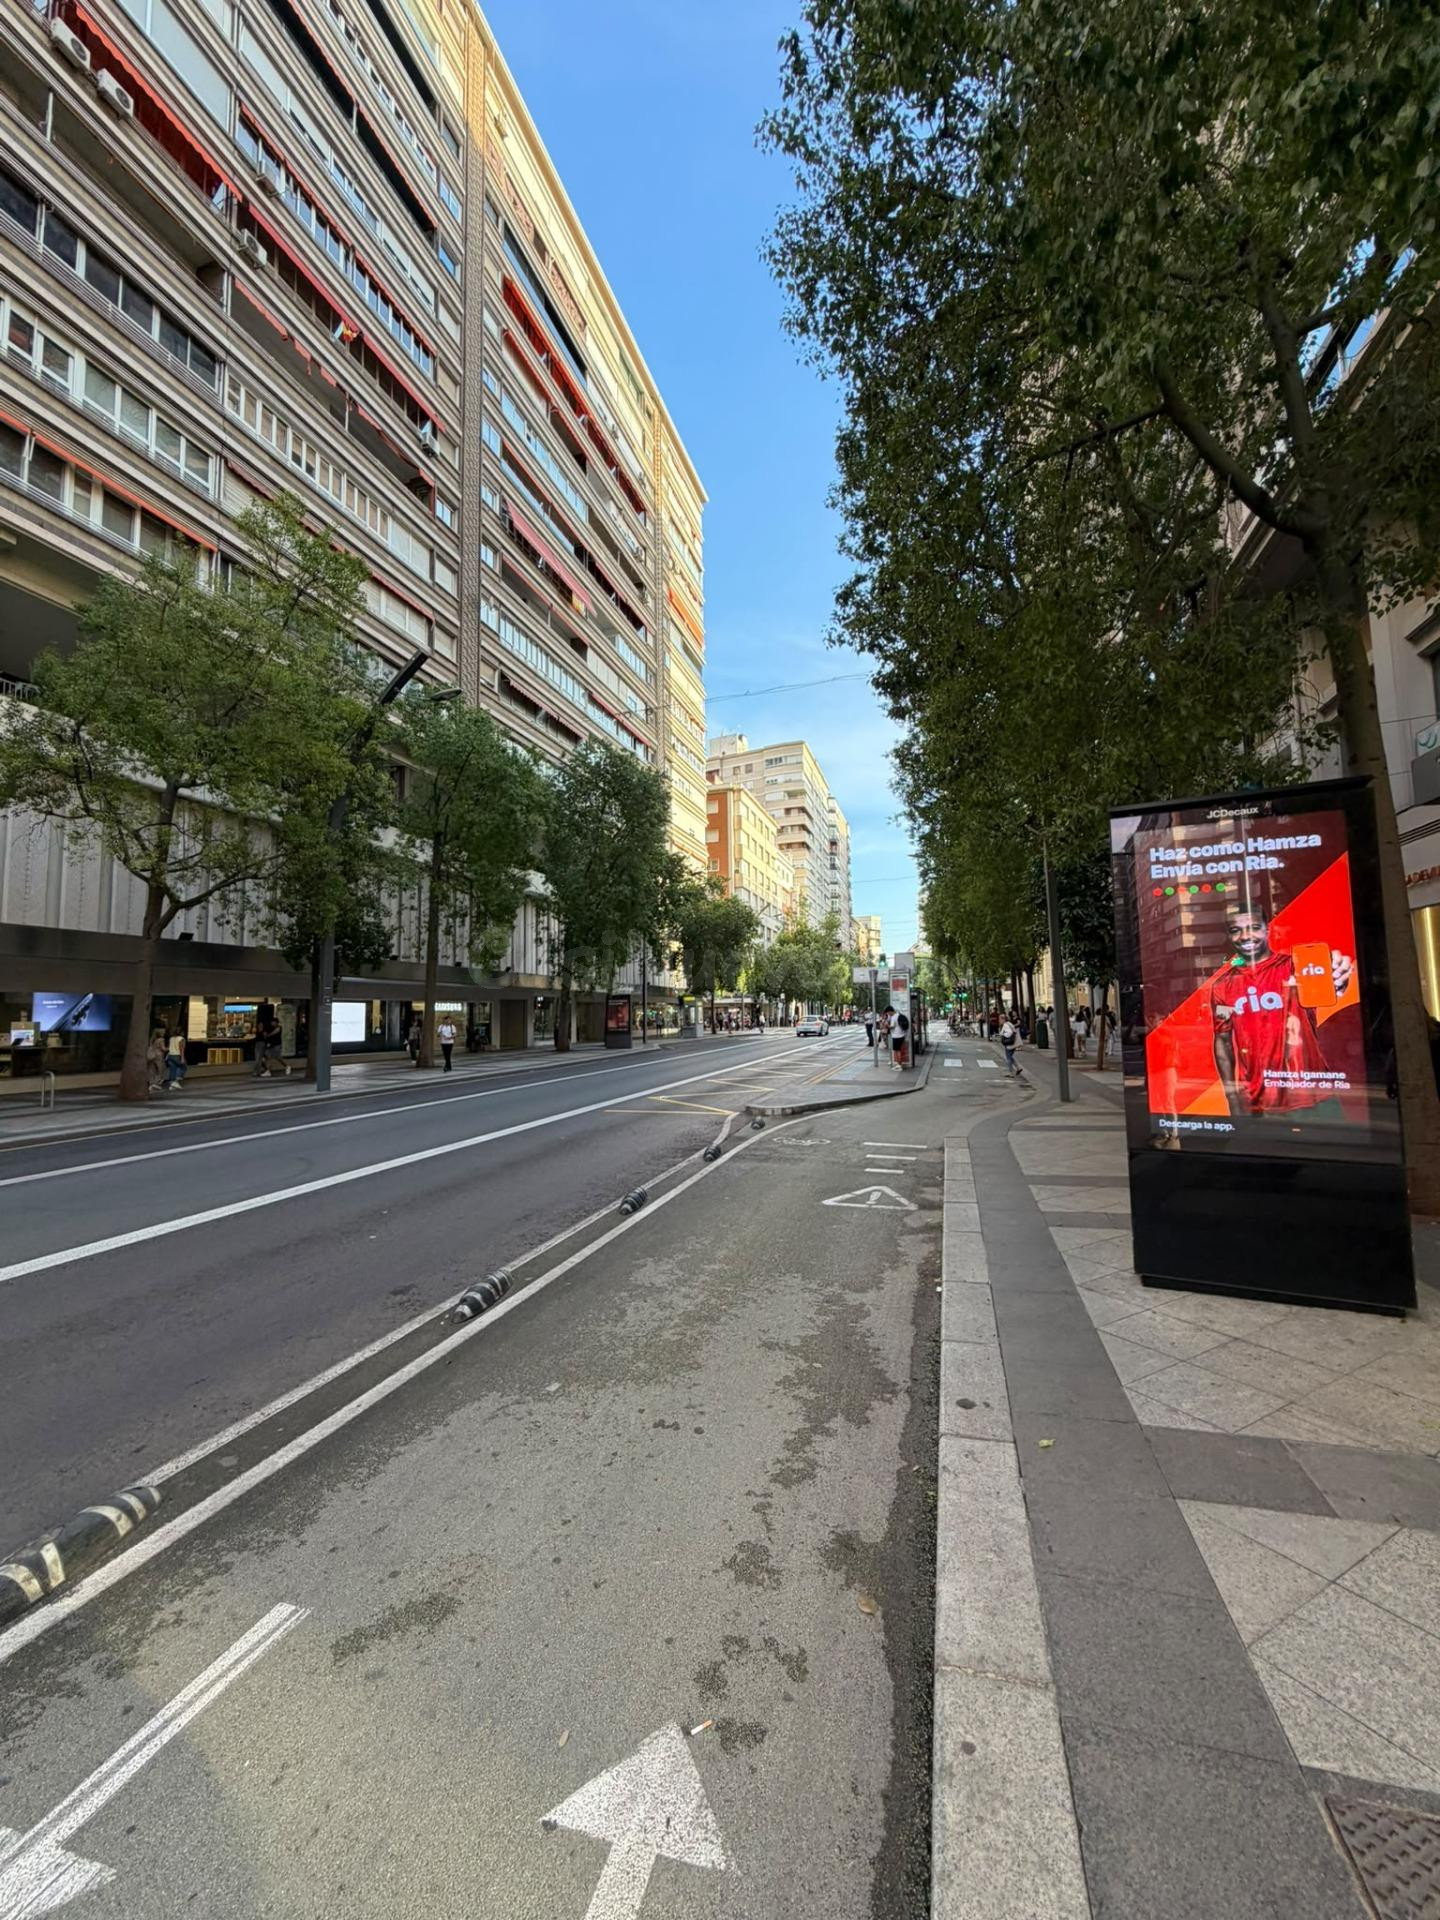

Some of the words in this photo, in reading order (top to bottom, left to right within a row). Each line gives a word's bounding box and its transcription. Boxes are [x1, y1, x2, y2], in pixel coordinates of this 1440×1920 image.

[1206, 806, 1259, 819] JCDecaux
[1150, 846, 1187, 862] Haz
[1189, 842, 1246, 858] como
[1247, 834, 1322, 853] Hamza
[1150, 860, 1203, 879] Envía
[1205, 860, 1243, 874] con
[1245, 854, 1285, 871] Ria.
[1302, 963, 1325, 976] ria
[1234, 986, 1284, 1015] ria
[1263, 1069, 1299, 1078] Hamza
[1300, 1070, 1346, 1080] Igamane
[1264, 1079, 1316, 1089] Embajador
[1318, 1081, 1332, 1089] de
[1334, 1081, 1351, 1089] Ria
[1159, 1119, 1202, 1131] Descarga
[1203, 1121, 1213, 1130] la
[1214, 1122, 1236, 1132] app.
